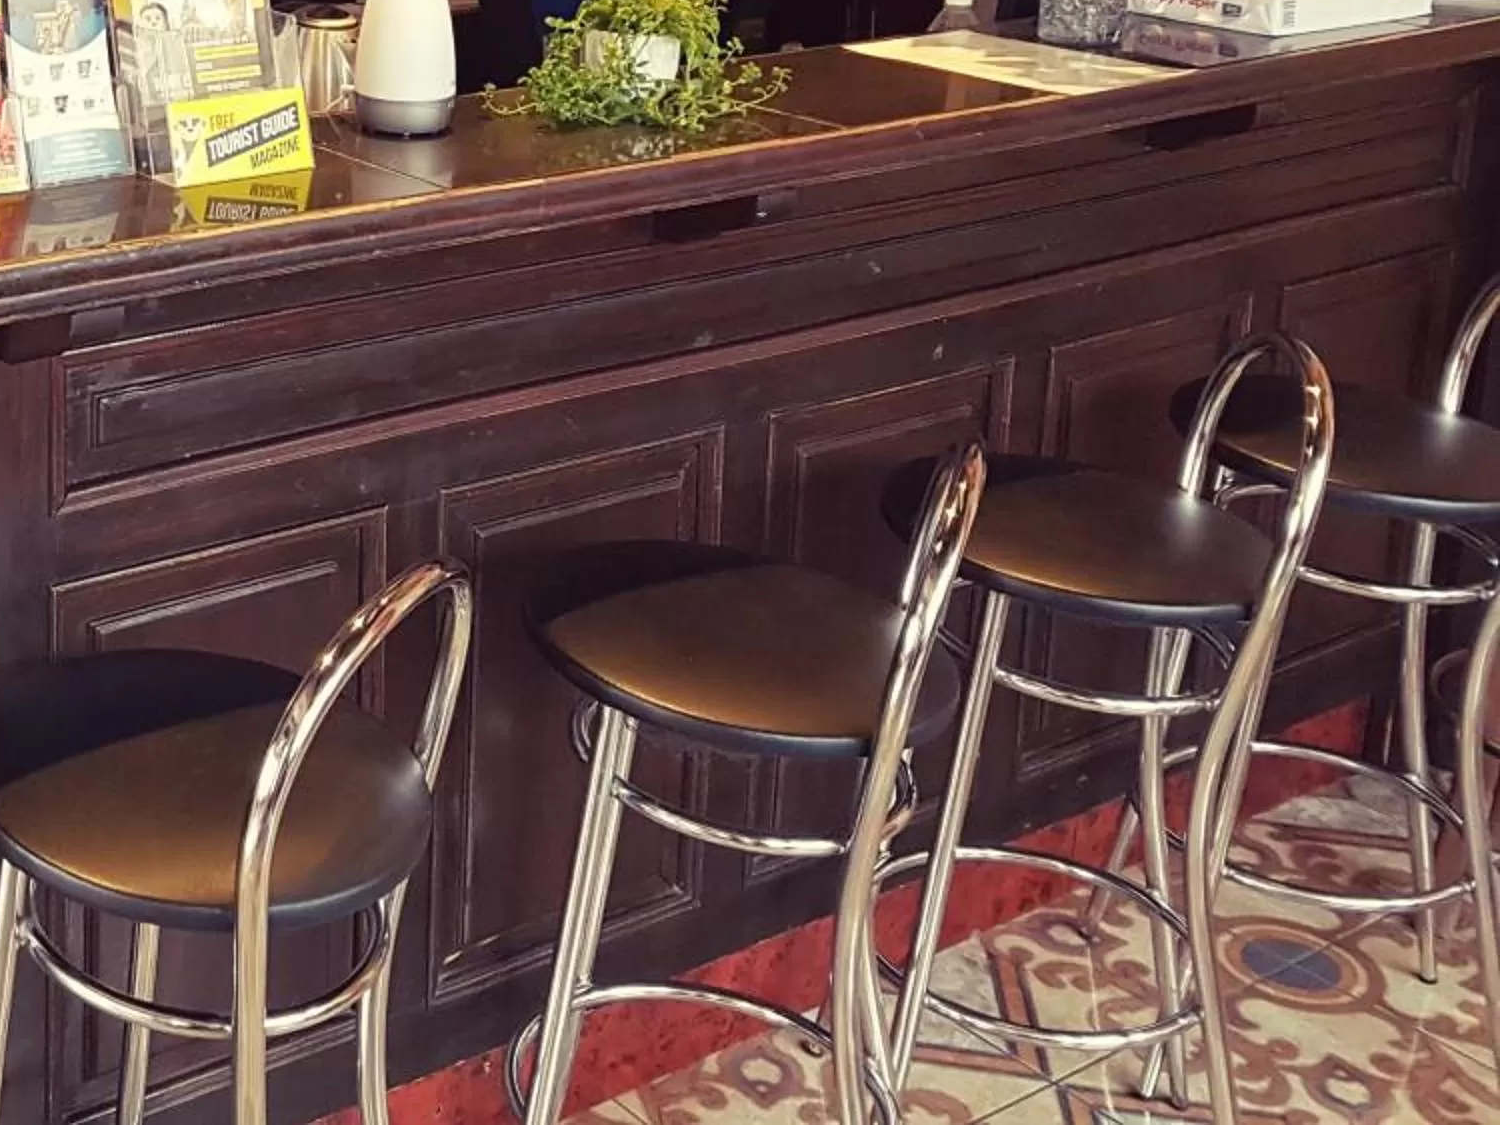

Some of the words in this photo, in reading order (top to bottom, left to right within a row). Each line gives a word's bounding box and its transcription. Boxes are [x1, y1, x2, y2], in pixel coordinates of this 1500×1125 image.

[208, 122, 261, 162] TOURIST
[260, 105, 298, 138] GUIDE
[209, 111, 236, 132] FREE
[249, 135, 301, 170] MAGAZINE
